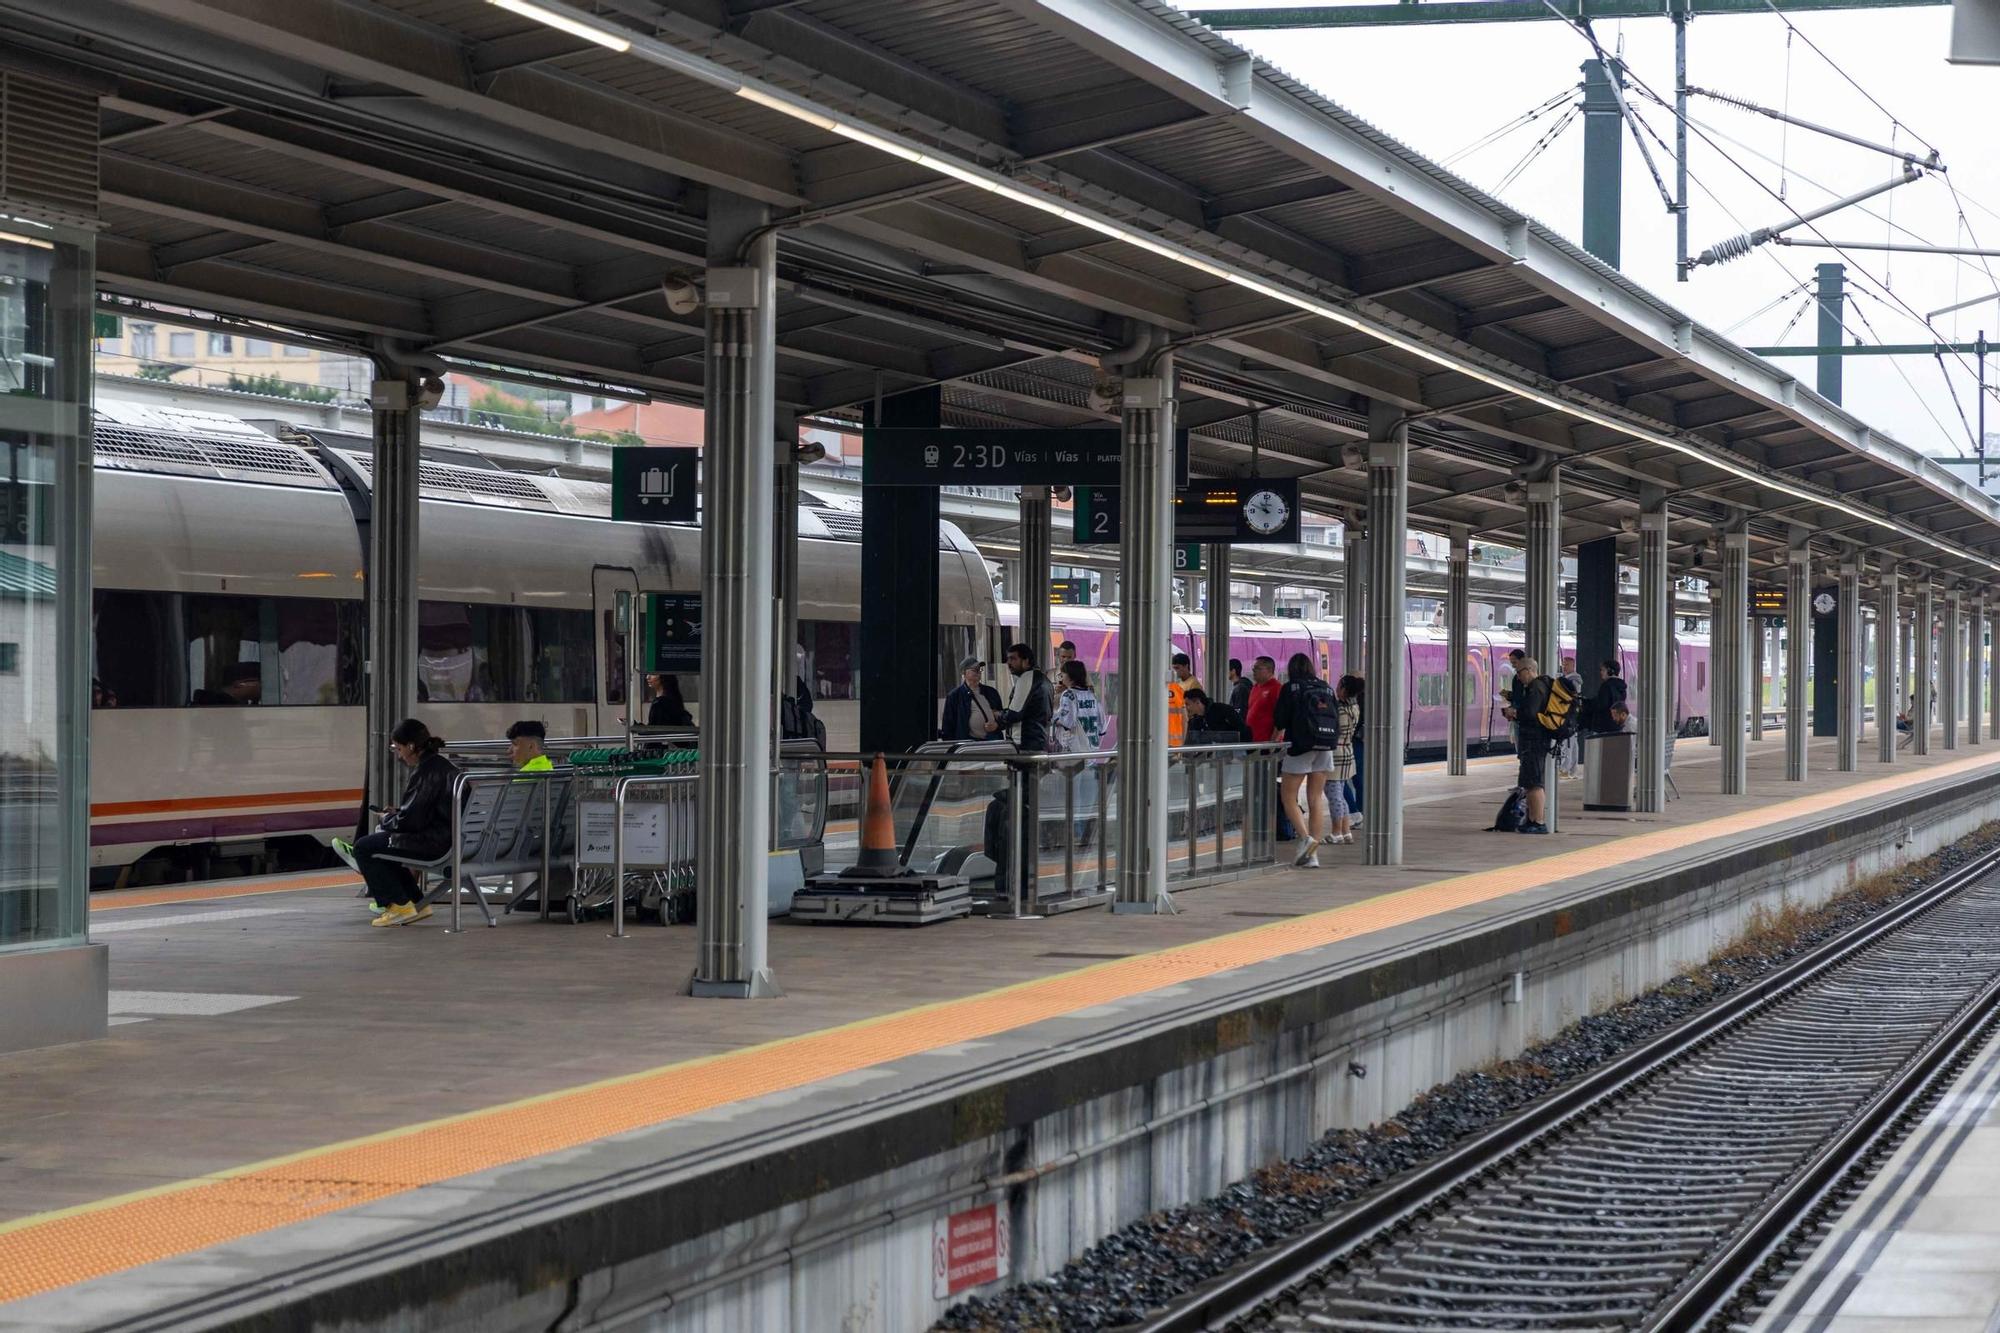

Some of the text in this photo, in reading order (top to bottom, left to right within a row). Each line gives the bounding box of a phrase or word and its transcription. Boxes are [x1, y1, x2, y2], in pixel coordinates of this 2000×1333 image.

[1014, 450, 1038, 462] Vías
[1055, 450, 1079, 462] Vías
[1094, 512, 1109, 533] 2
[1175, 549, 1187, 568] B
[1570, 596, 1577, 608] 2
[1762, 617, 1777, 626] 2 C
